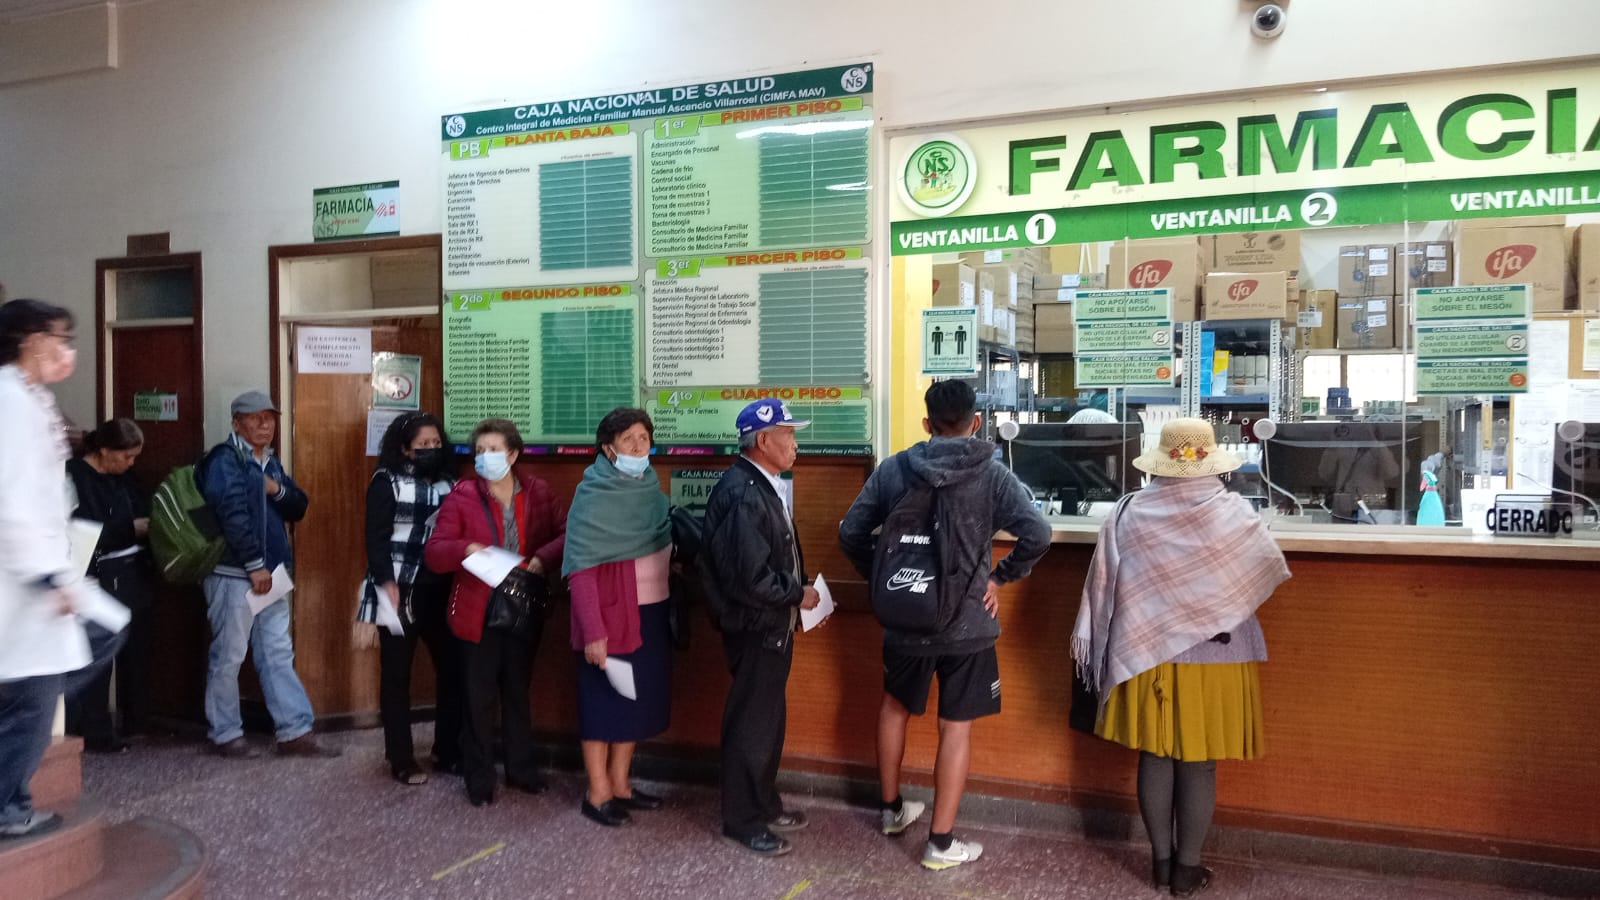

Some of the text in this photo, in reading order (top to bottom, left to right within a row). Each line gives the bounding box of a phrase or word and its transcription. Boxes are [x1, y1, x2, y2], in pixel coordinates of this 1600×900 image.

[514, 76, 776, 120] CAJA NACIONAL DE SALUD
[476, 86, 826, 136] Centro Integral de Medicina Familiar Manuel Ascencio Villarroel (CIMFA MAV)
[720, 106, 793, 125] PRIMER
[796, 99, 842, 117] PISO
[504, 124, 615, 147] PLANTA BAJA
[1009, 87, 1600, 196] FARMACI
[459, 141, 480, 158] PB
[316, 197, 374, 217] FARMACIA
[1450, 186, 1600, 212] VENTANILL
[1150, 197, 1330, 231] VENTANILLA 2
[898, 224, 1019, 250] VENTANILLA
[724, 249, 846, 266] TERCER PISO
[1492, 249, 1522, 278] ifa
[1134, 262, 1161, 289] ifa
[459, 294, 483, 310] 2do
[502, 285, 622, 301] SEGUNDO PISO
[1232, 282, 1250, 302] ifa
[720, 386, 842, 400] CUARTO PISO
[682, 484, 702, 498] FILA
[909, 582, 929, 594] AIR
